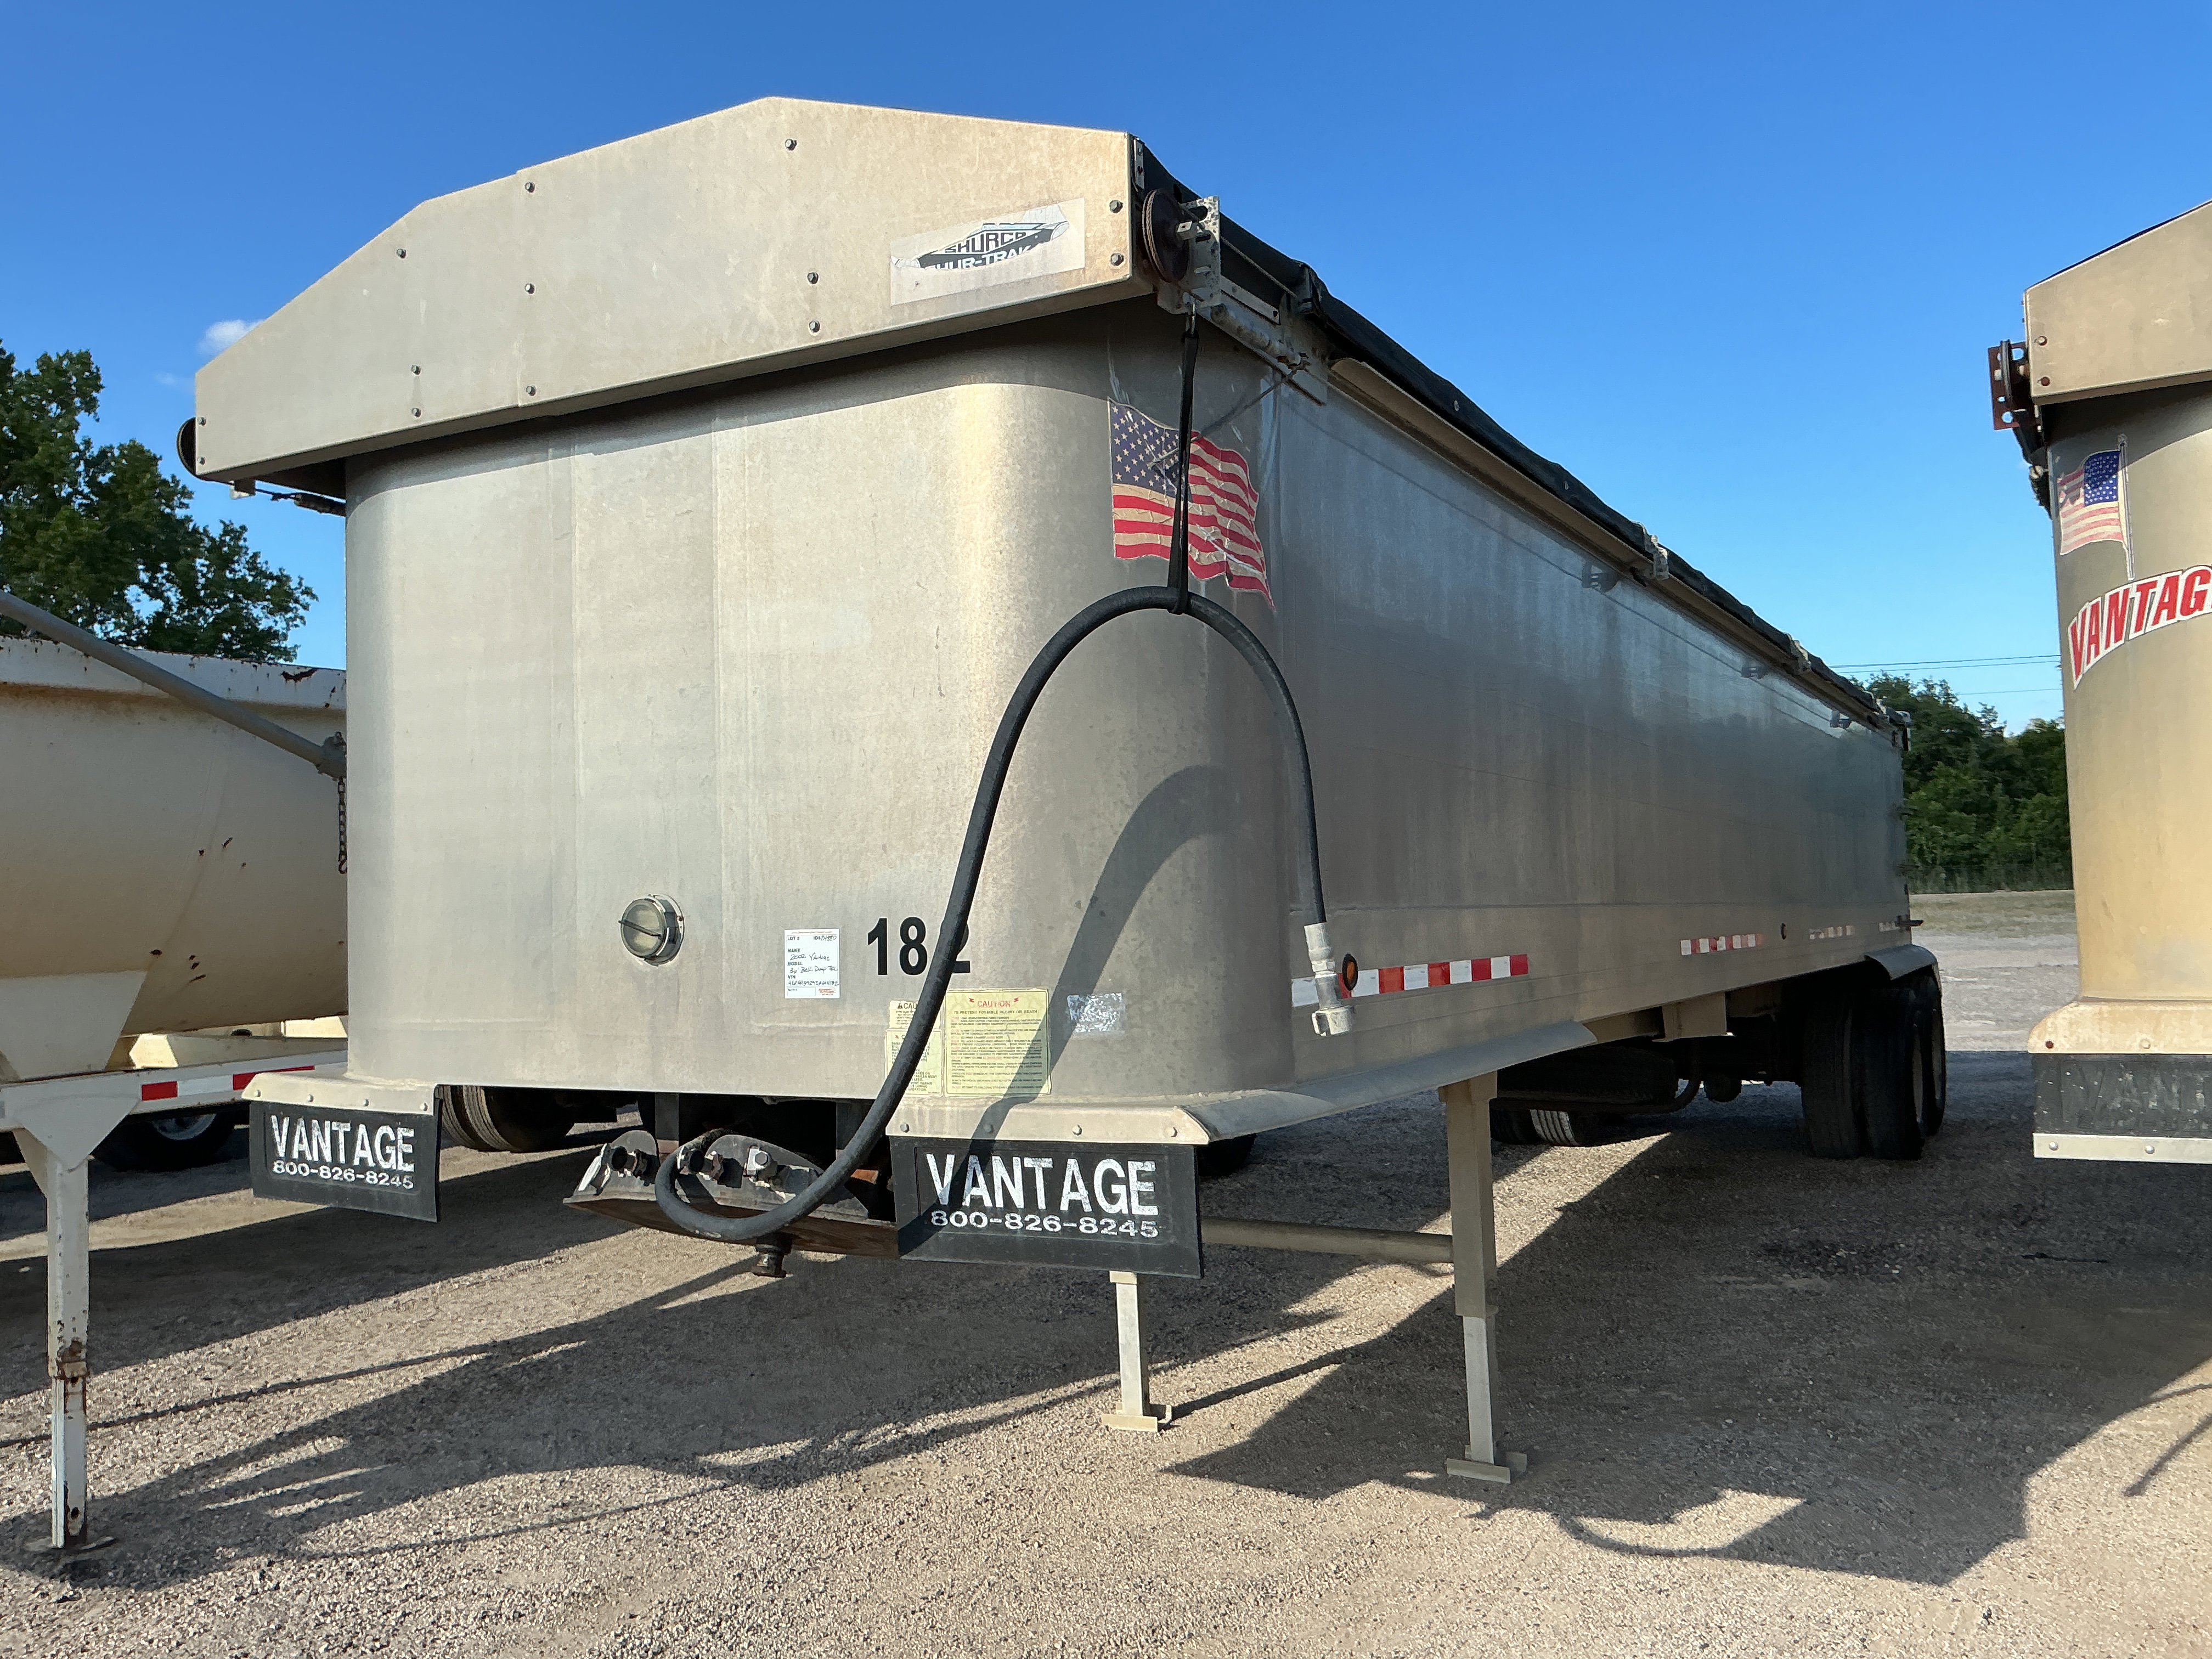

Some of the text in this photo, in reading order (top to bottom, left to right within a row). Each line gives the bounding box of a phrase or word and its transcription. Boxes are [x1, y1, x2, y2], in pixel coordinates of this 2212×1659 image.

[926, 245, 1032, 269] HUR-TRAK
[2068, 566, 2212, 690] VANTAG
[271, 1115, 415, 1172] VANTAGE
[273, 1160, 414, 1189] 800-826-8245
[926, 1153, 1159, 1216] VANTAGE
[931, 1210, 1159, 1238] 800-826-8245
